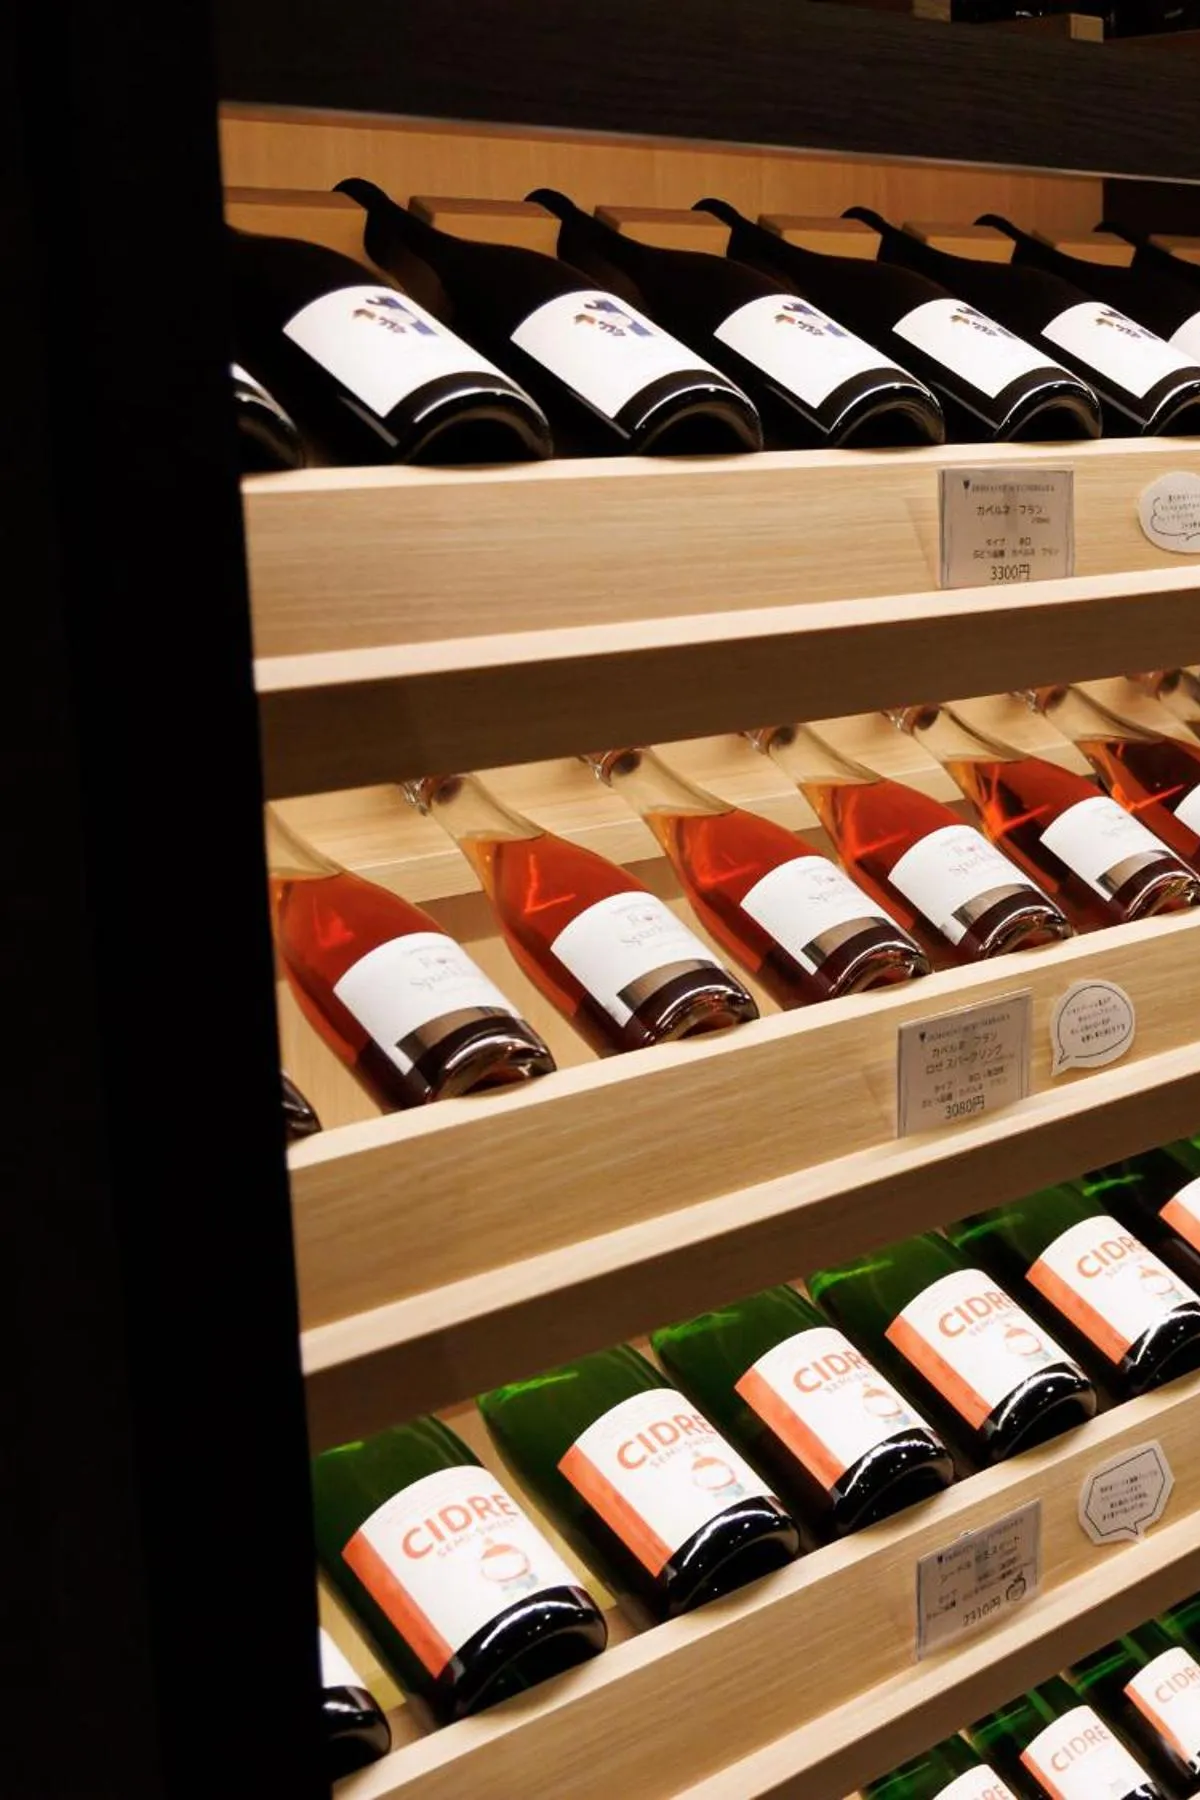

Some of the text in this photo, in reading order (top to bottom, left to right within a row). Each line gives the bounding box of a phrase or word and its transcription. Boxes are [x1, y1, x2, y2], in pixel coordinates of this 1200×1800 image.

[990, 563, 1030, 580] 3300円
[945, 1094, 985, 1119] 3080円
[616, 1413, 716, 1471] CIDRE
[401, 1494, 518, 1560] CIDRE
